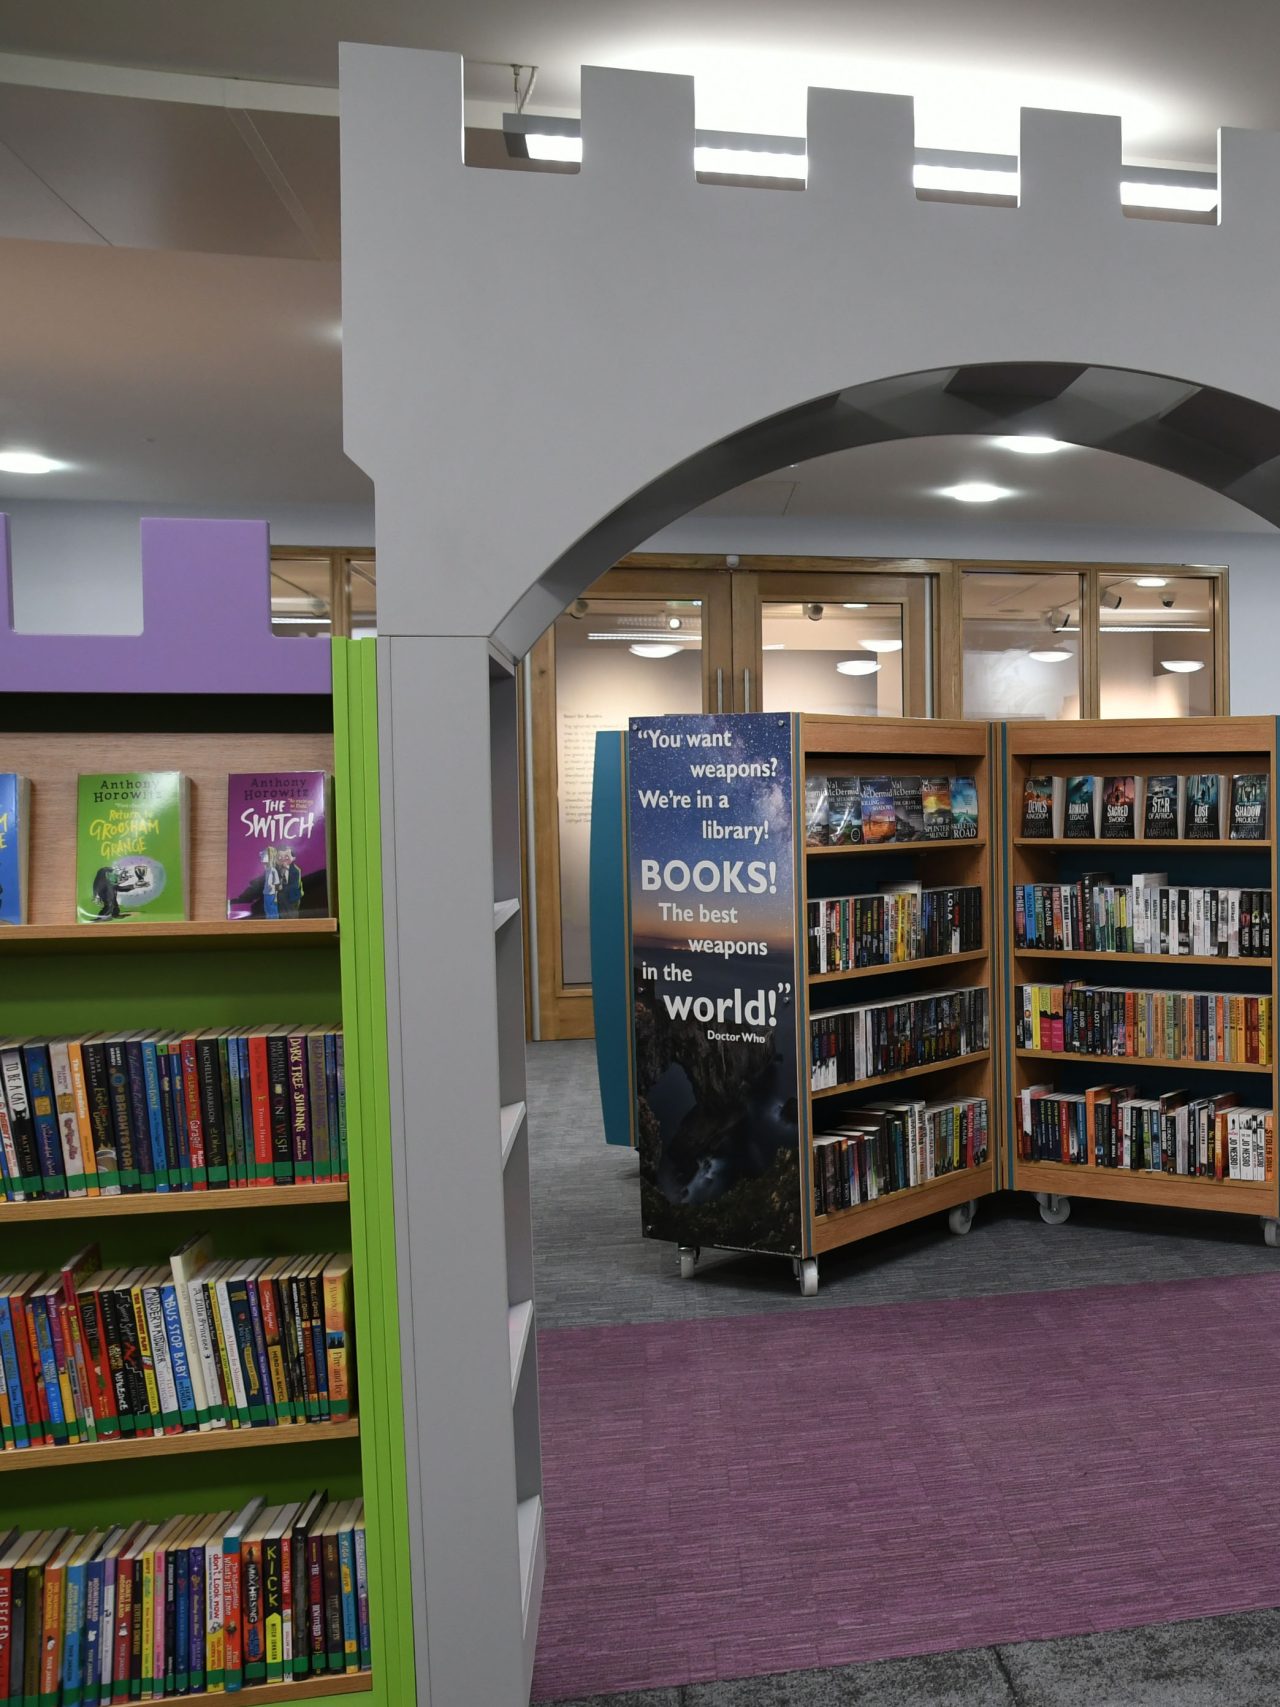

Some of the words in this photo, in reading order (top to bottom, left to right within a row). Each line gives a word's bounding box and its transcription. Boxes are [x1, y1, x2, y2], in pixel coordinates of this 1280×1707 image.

[638, 730, 680, 748] “You
[686, 731, 732, 747] want
[690, 758, 777, 783] weapons?
[100, 780, 159, 790] Anthony
[251, 777, 306, 788] Anthony
[94, 790, 162, 802] Horowitz
[244, 789, 309, 800] Horowitz
[638, 790, 691, 808] We’re
[696, 790, 712, 808] in
[719, 795, 729, 808] a
[262, 799, 286, 813] THE
[1107, 805, 1128, 817] SACRED
[1152, 798, 1170, 813] STAR
[1195, 805, 1208, 817] LOST
[1235, 805, 1261, 817] SHADOW
[89, 819, 159, 841] GROOSHAM
[702, 820, 769, 845] library!
[954, 829, 976, 839] ROAD
[101, 836, 147, 860] GRANGE
[641, 859, 777, 894] BOOKS!
[658, 902, 694, 922] The
[700, 904, 738, 924] best
[688, 939, 768, 959] weapons
[642, 961, 658, 980] in
[663, 963, 693, 982] the
[663, 982, 791, 1027] world!”
[707, 1029, 741, 1042] Doctor
[741, 1032, 765, 1044] Who
[289, 1038, 302, 1062] DARK
[6, 1062, 19, 1072] TO
[72, 1058, 80, 1073] The
[202, 1046, 213, 1083] MICHELLE
[7, 1073, 21, 1083] BE
[292, 1064, 304, 1089] TREE
[10, 1093, 25, 1105] CAT
[75, 1090, 85, 1119] Medicine
[293, 1092, 307, 1132] SHINING
[259, 1129, 267, 1157] Harrison
[275, 1123, 288, 1153] WISH
[1229, 1138, 1237, 1146] JO
[1242, 1139, 1249, 1147] JO
[1257, 1144, 1263, 1152] JO
[164, 1300, 177, 1321] BUS
[169, 1324, 182, 1348] STOP
[174, 1351, 186, 1377] BABY
[272, 1351, 280, 1367] HERO
[333, 1352, 342, 1367] Fire
[233, 1367, 242, 1393] Shimmer
[334, 1369, 343, 1382] and
[335, 1384, 343, 1395] Ice
[248, 1564, 258, 1586] MAX
[267, 1545, 278, 1607] KICK
[214, 1578, 222, 1598] Look
[224, 1581, 232, 1593] His
[213, 1601, 221, 1618] now
[248, 1586, 257, 1623] HELSING
